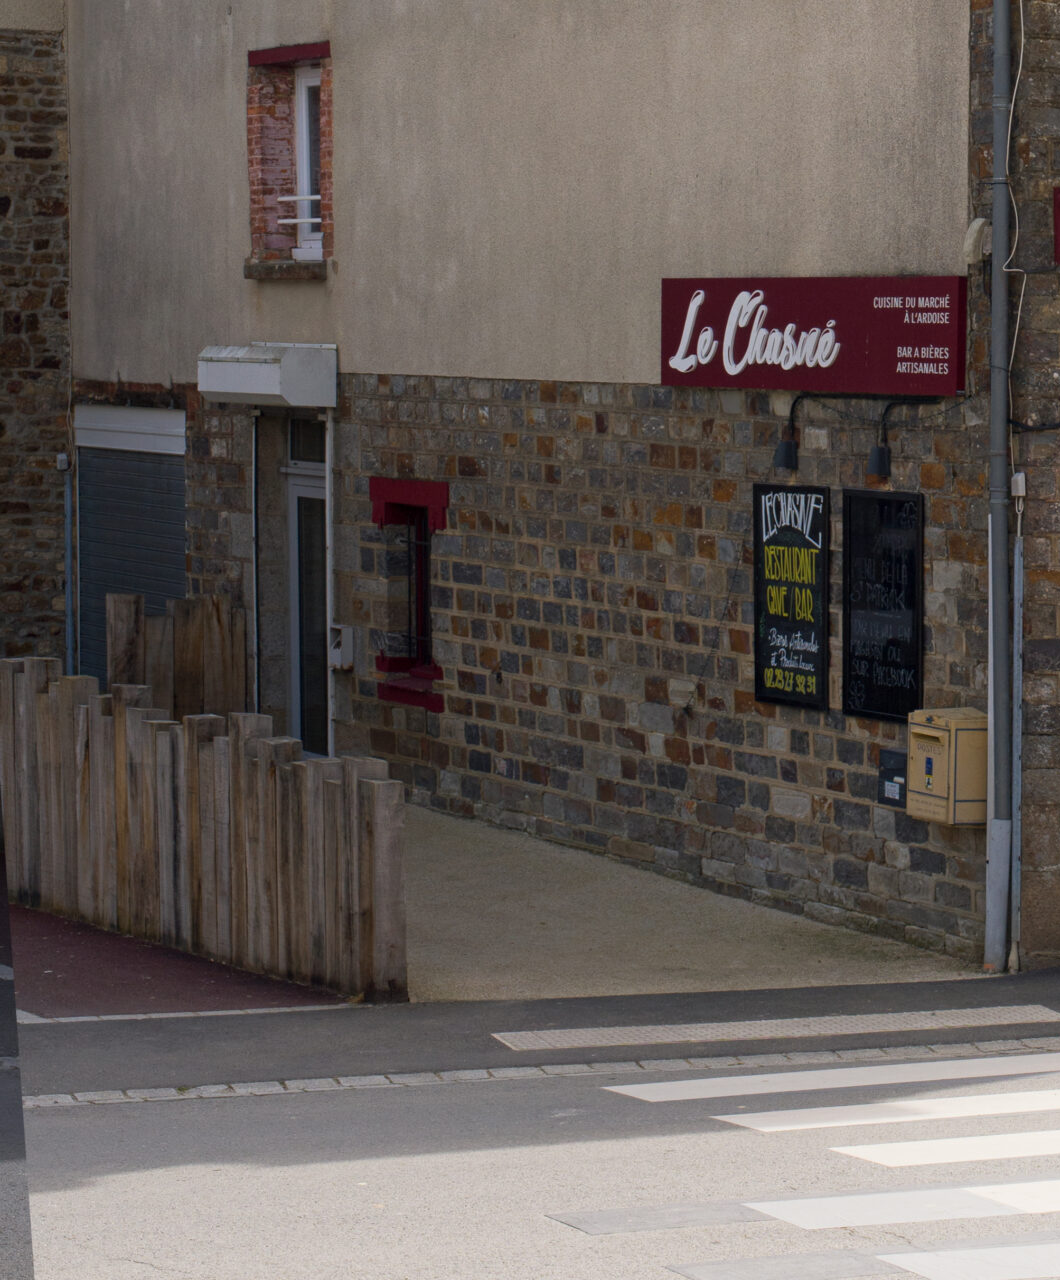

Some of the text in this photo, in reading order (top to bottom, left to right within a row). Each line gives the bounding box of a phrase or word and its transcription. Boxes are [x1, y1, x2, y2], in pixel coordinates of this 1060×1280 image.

[873, 293, 950, 309] CUISINE DU MARCHÉ
[903, 309, 910, 324] À
[668, 289, 841, 376] Le Chasné
[897, 346, 912, 358] BAR
[921, 344, 949, 359] BIÈRES
[896, 361, 949, 375] ARTISANALES
[764, 545, 820, 586] RESTAURANT
[766, 584, 789, 617] CAVE
[794, 587, 815, 622] BAR
